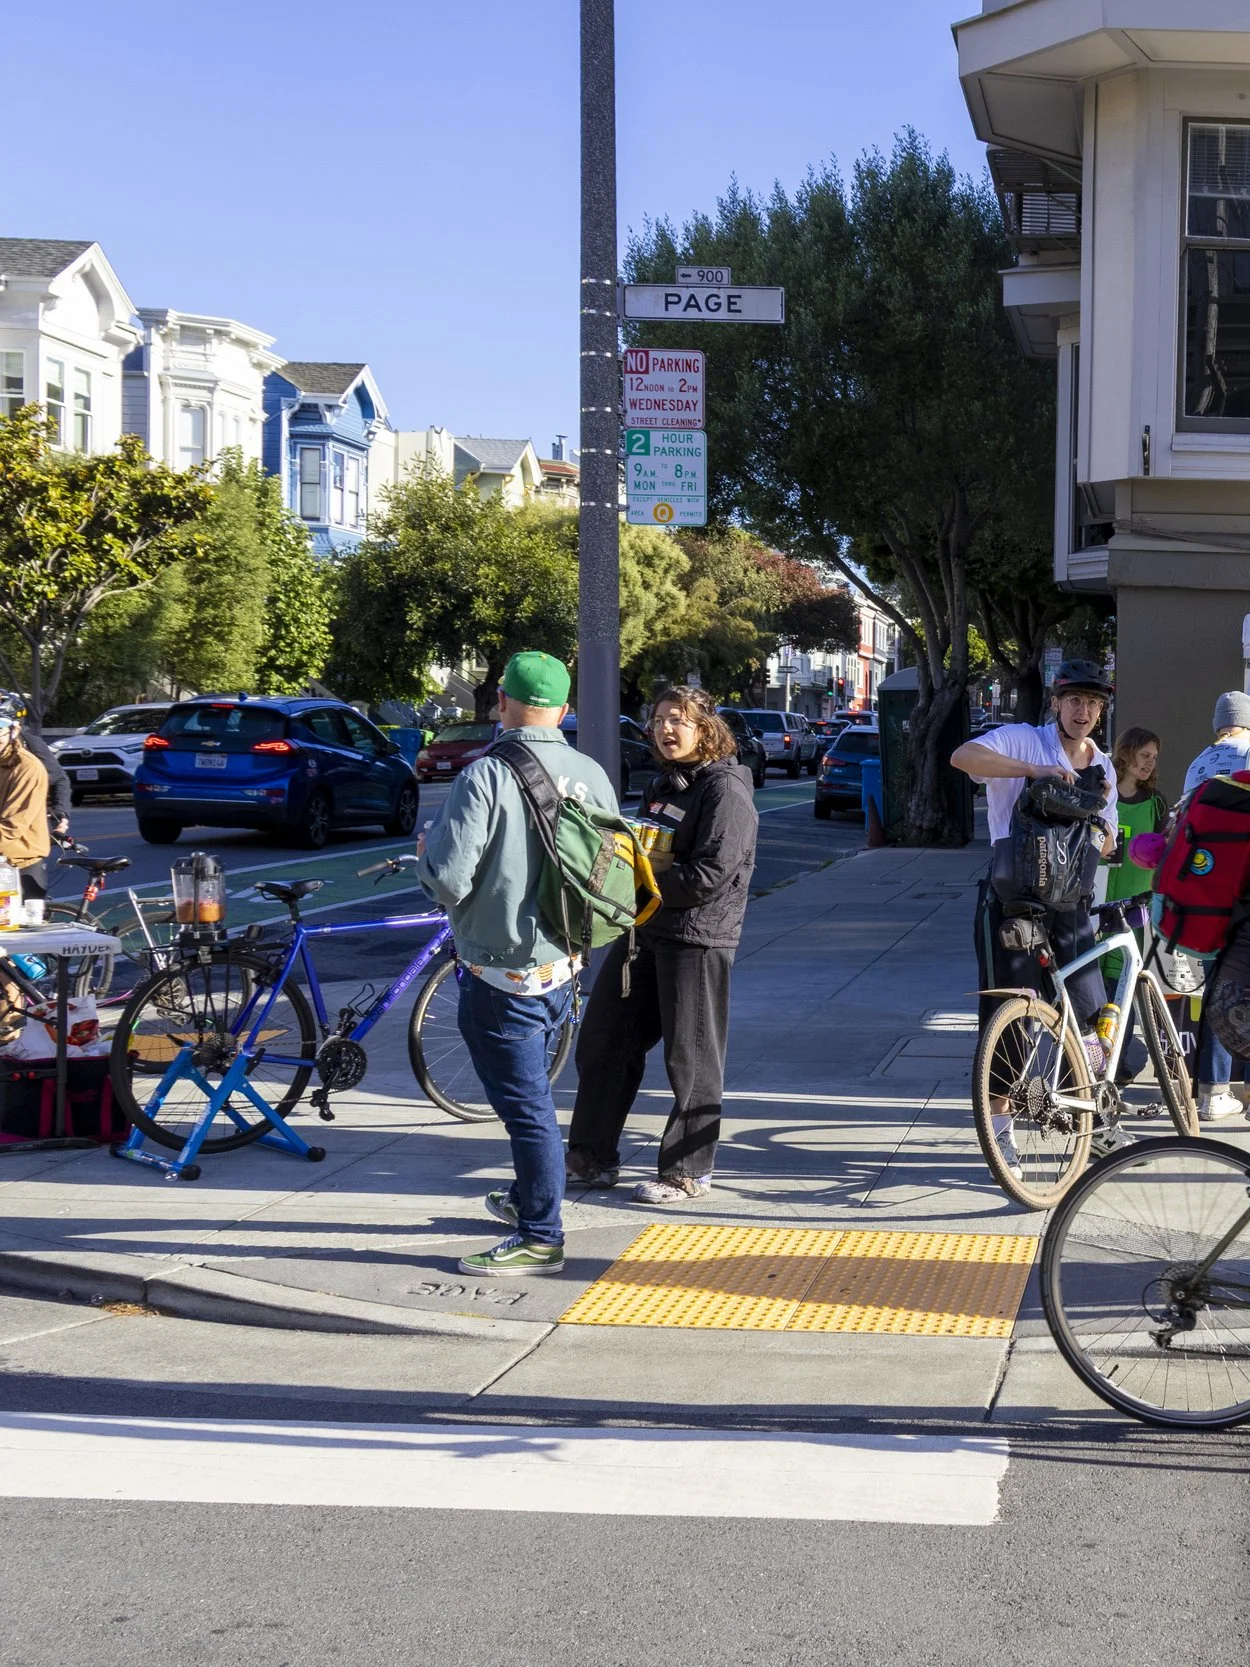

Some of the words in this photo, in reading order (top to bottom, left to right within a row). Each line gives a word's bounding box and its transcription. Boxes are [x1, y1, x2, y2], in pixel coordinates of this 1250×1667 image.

[697, 270, 724, 283] 900
[664, 293, 742, 313] PAGE
[627, 352, 646, 371] NO
[652, 357, 700, 373] PARKING
[629, 398, 698, 412] WEDNESDAY
[631, 417, 658, 425] STREET
[662, 418, 698, 427] CLEANING
[631, 433, 645, 453] 2
[662, 433, 693, 443] HOUR
[653, 447, 702, 457] PARKING
[634, 481, 656, 490] MON
[681, 482, 697, 491] FRI
[1037, 836, 1047, 887] patagonia
